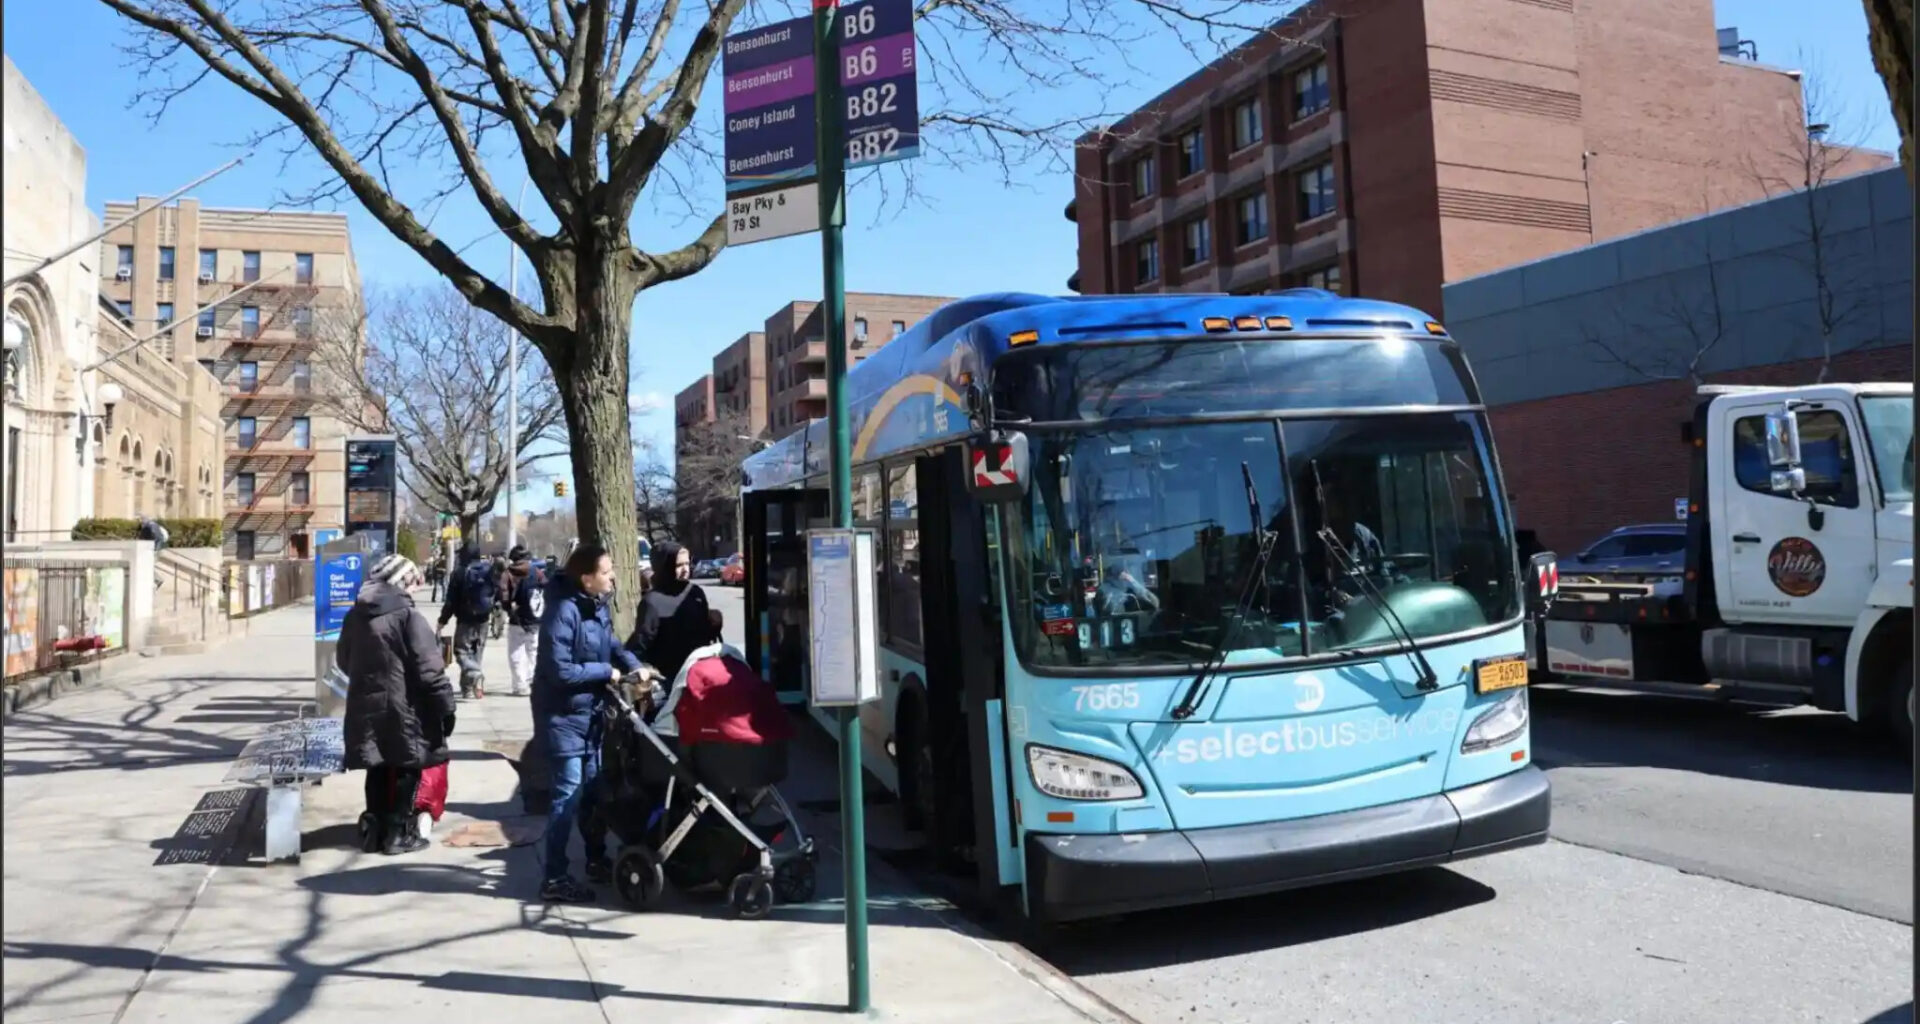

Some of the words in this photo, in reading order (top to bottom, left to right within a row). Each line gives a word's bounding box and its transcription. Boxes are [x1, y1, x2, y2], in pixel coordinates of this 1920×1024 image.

[844, 5, 875, 39] B6
[727, 28, 791, 54] Bensonhurst
[846, 46, 877, 79] B6
[902, 47, 912, 68] LTD
[728, 67, 793, 93] Bensonhurst
[847, 83, 897, 120] B82
[729, 113, 760, 132] Coney
[763, 105, 795, 125] Island
[849, 128, 899, 163] B82
[729, 147, 794, 172] Bensonhurst
[732, 200, 750, 216] Bay
[755, 196, 773, 212] Pky
[777, 194, 786, 206] &
[733, 220, 745, 232] 79
[749, 216, 760, 228] St
[330, 573, 345, 581] Get
[330, 581, 354, 589] Ticket
[1072, 683, 1140, 711] 7665
